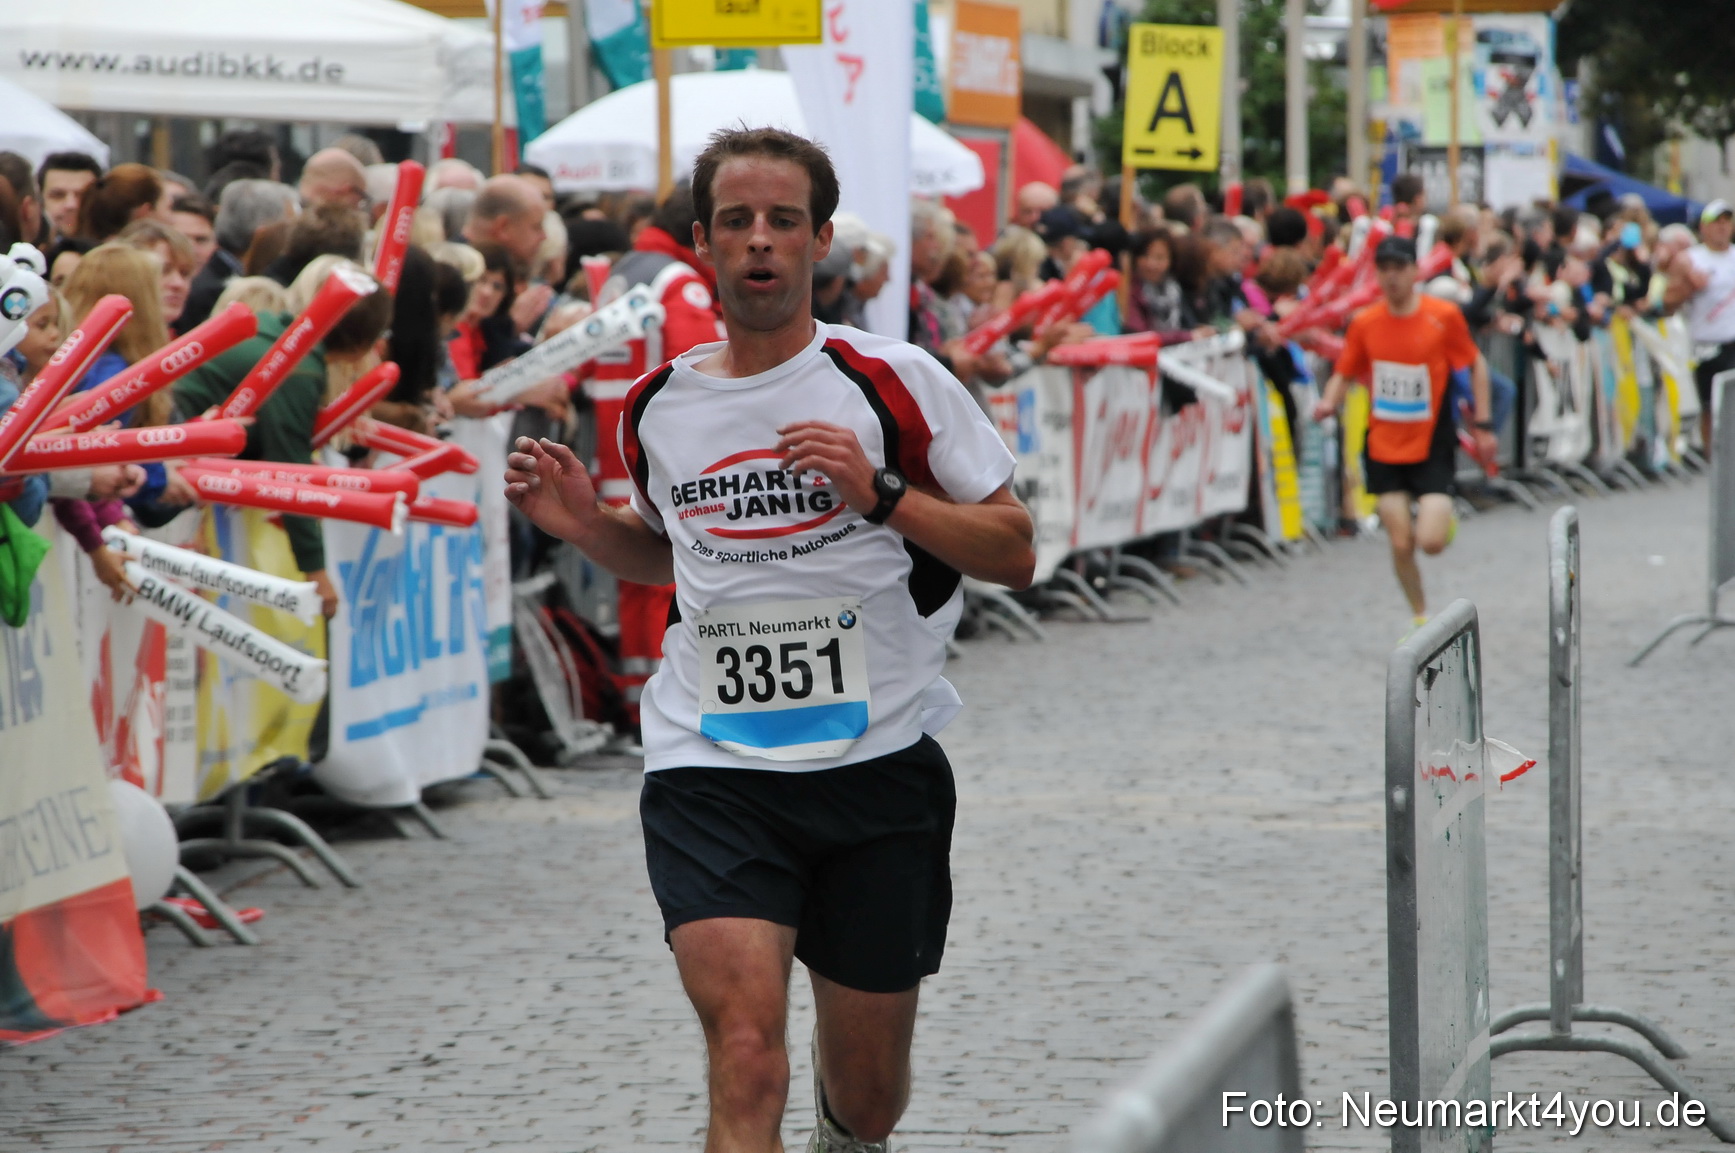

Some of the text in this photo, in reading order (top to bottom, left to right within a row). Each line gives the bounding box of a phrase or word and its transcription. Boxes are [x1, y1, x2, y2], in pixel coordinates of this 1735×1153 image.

[1141, 31, 1209, 56] Block
[19, 50, 347, 83] www.audibkk.de
[1148, 70, 1195, 133] A
[17, 378, 46, 410] BKK
[68, 372, 150, 430] Audi BKK
[24, 434, 121, 455] Audi BKK
[671, 470, 826, 507] GERHART &
[726, 491, 833, 521] JÄNIG
[678, 502, 726, 520] utohaus
[691, 523, 857, 563] Das sportliche Autohaus
[140, 549, 299, 612] bmw-laufsport.de
[138, 577, 303, 682] BMW Laufsport
[698, 616, 831, 638] PARTL Neumarkt
[716, 637, 845, 705] 3351
